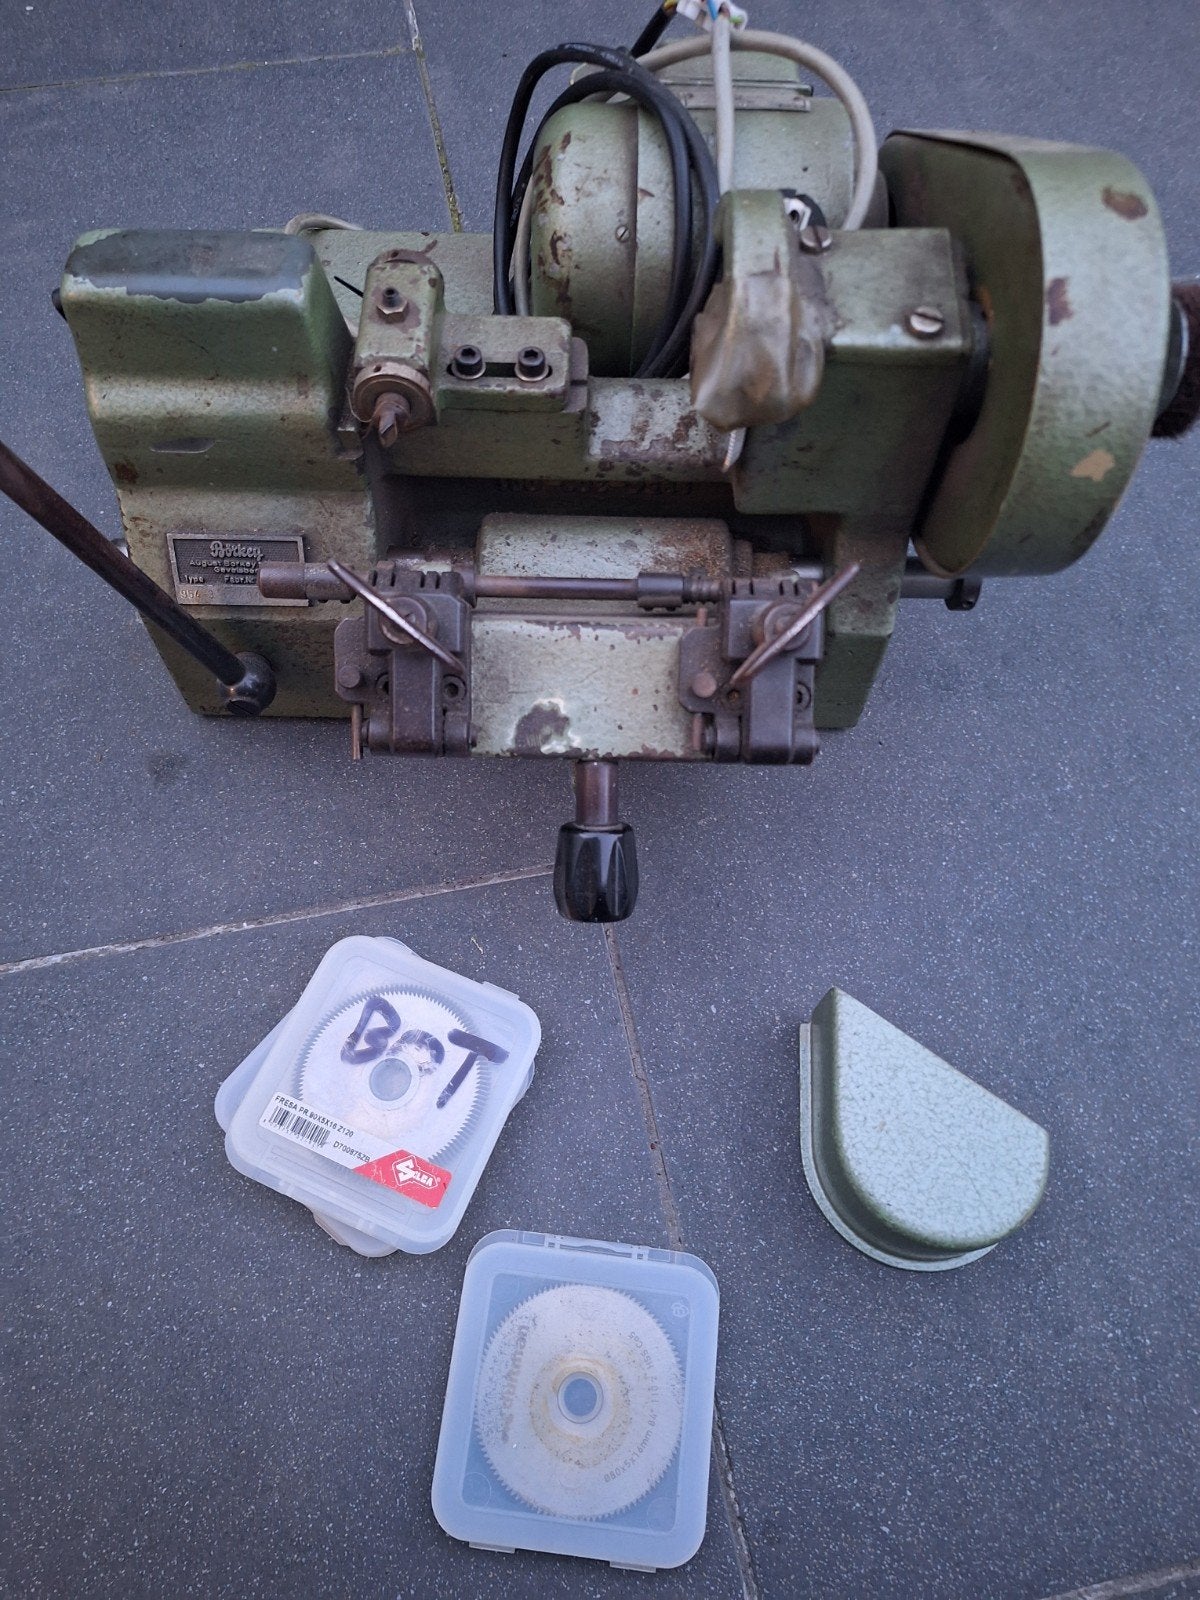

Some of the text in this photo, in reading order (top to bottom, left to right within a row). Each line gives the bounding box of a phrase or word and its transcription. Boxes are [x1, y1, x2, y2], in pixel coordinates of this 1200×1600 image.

[189, 559, 222, 568] August
[184, 574, 204, 584] Type
[274, 1094, 298, 1112] FRESA
[336, 1125, 355, 1138] Z120
